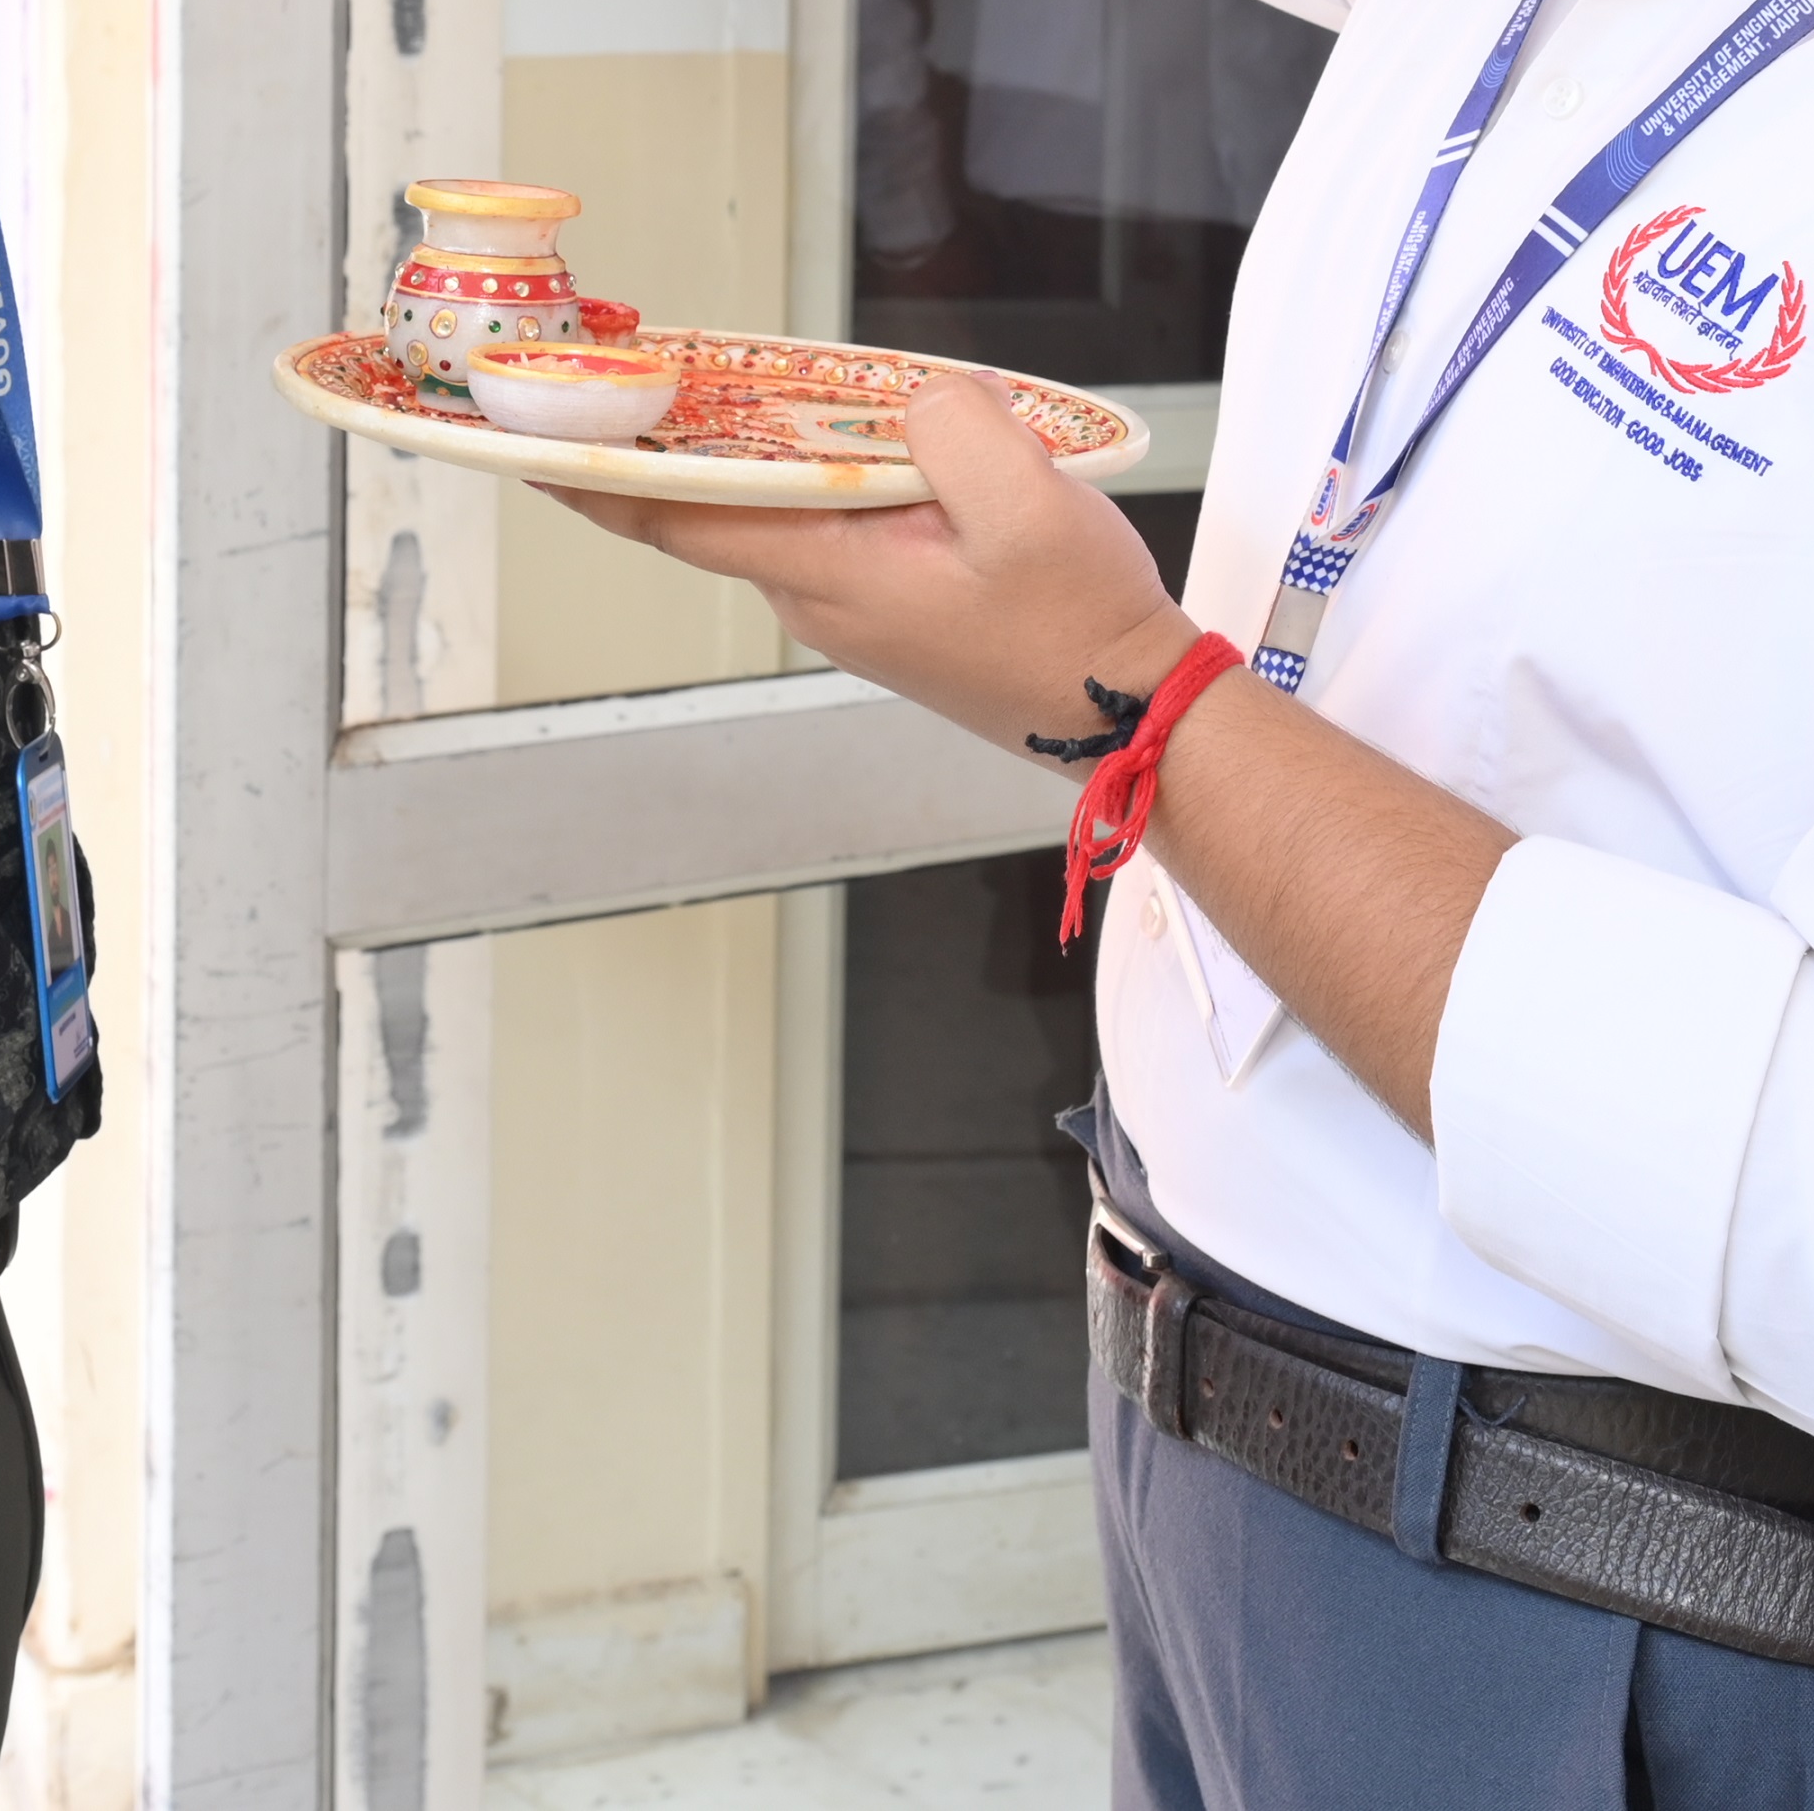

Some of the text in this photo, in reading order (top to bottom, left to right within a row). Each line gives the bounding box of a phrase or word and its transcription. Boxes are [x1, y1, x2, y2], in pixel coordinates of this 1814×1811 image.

[1640, 61, 1715, 136] UNIVERSITY
[1714, 43, 1734, 66] OF
[1661, 121, 1676, 136] &
[1674, 36, 1773, 124] MANAGEMENT,
[1402, 223, 1429, 275] JAIPUR
[1657, 219, 1779, 332] UEM
[1457, 276, 1515, 360] ENGINEERING
[1476, 299, 1512, 350] JAIPUR
[1664, 447, 1704, 482] JOBS
